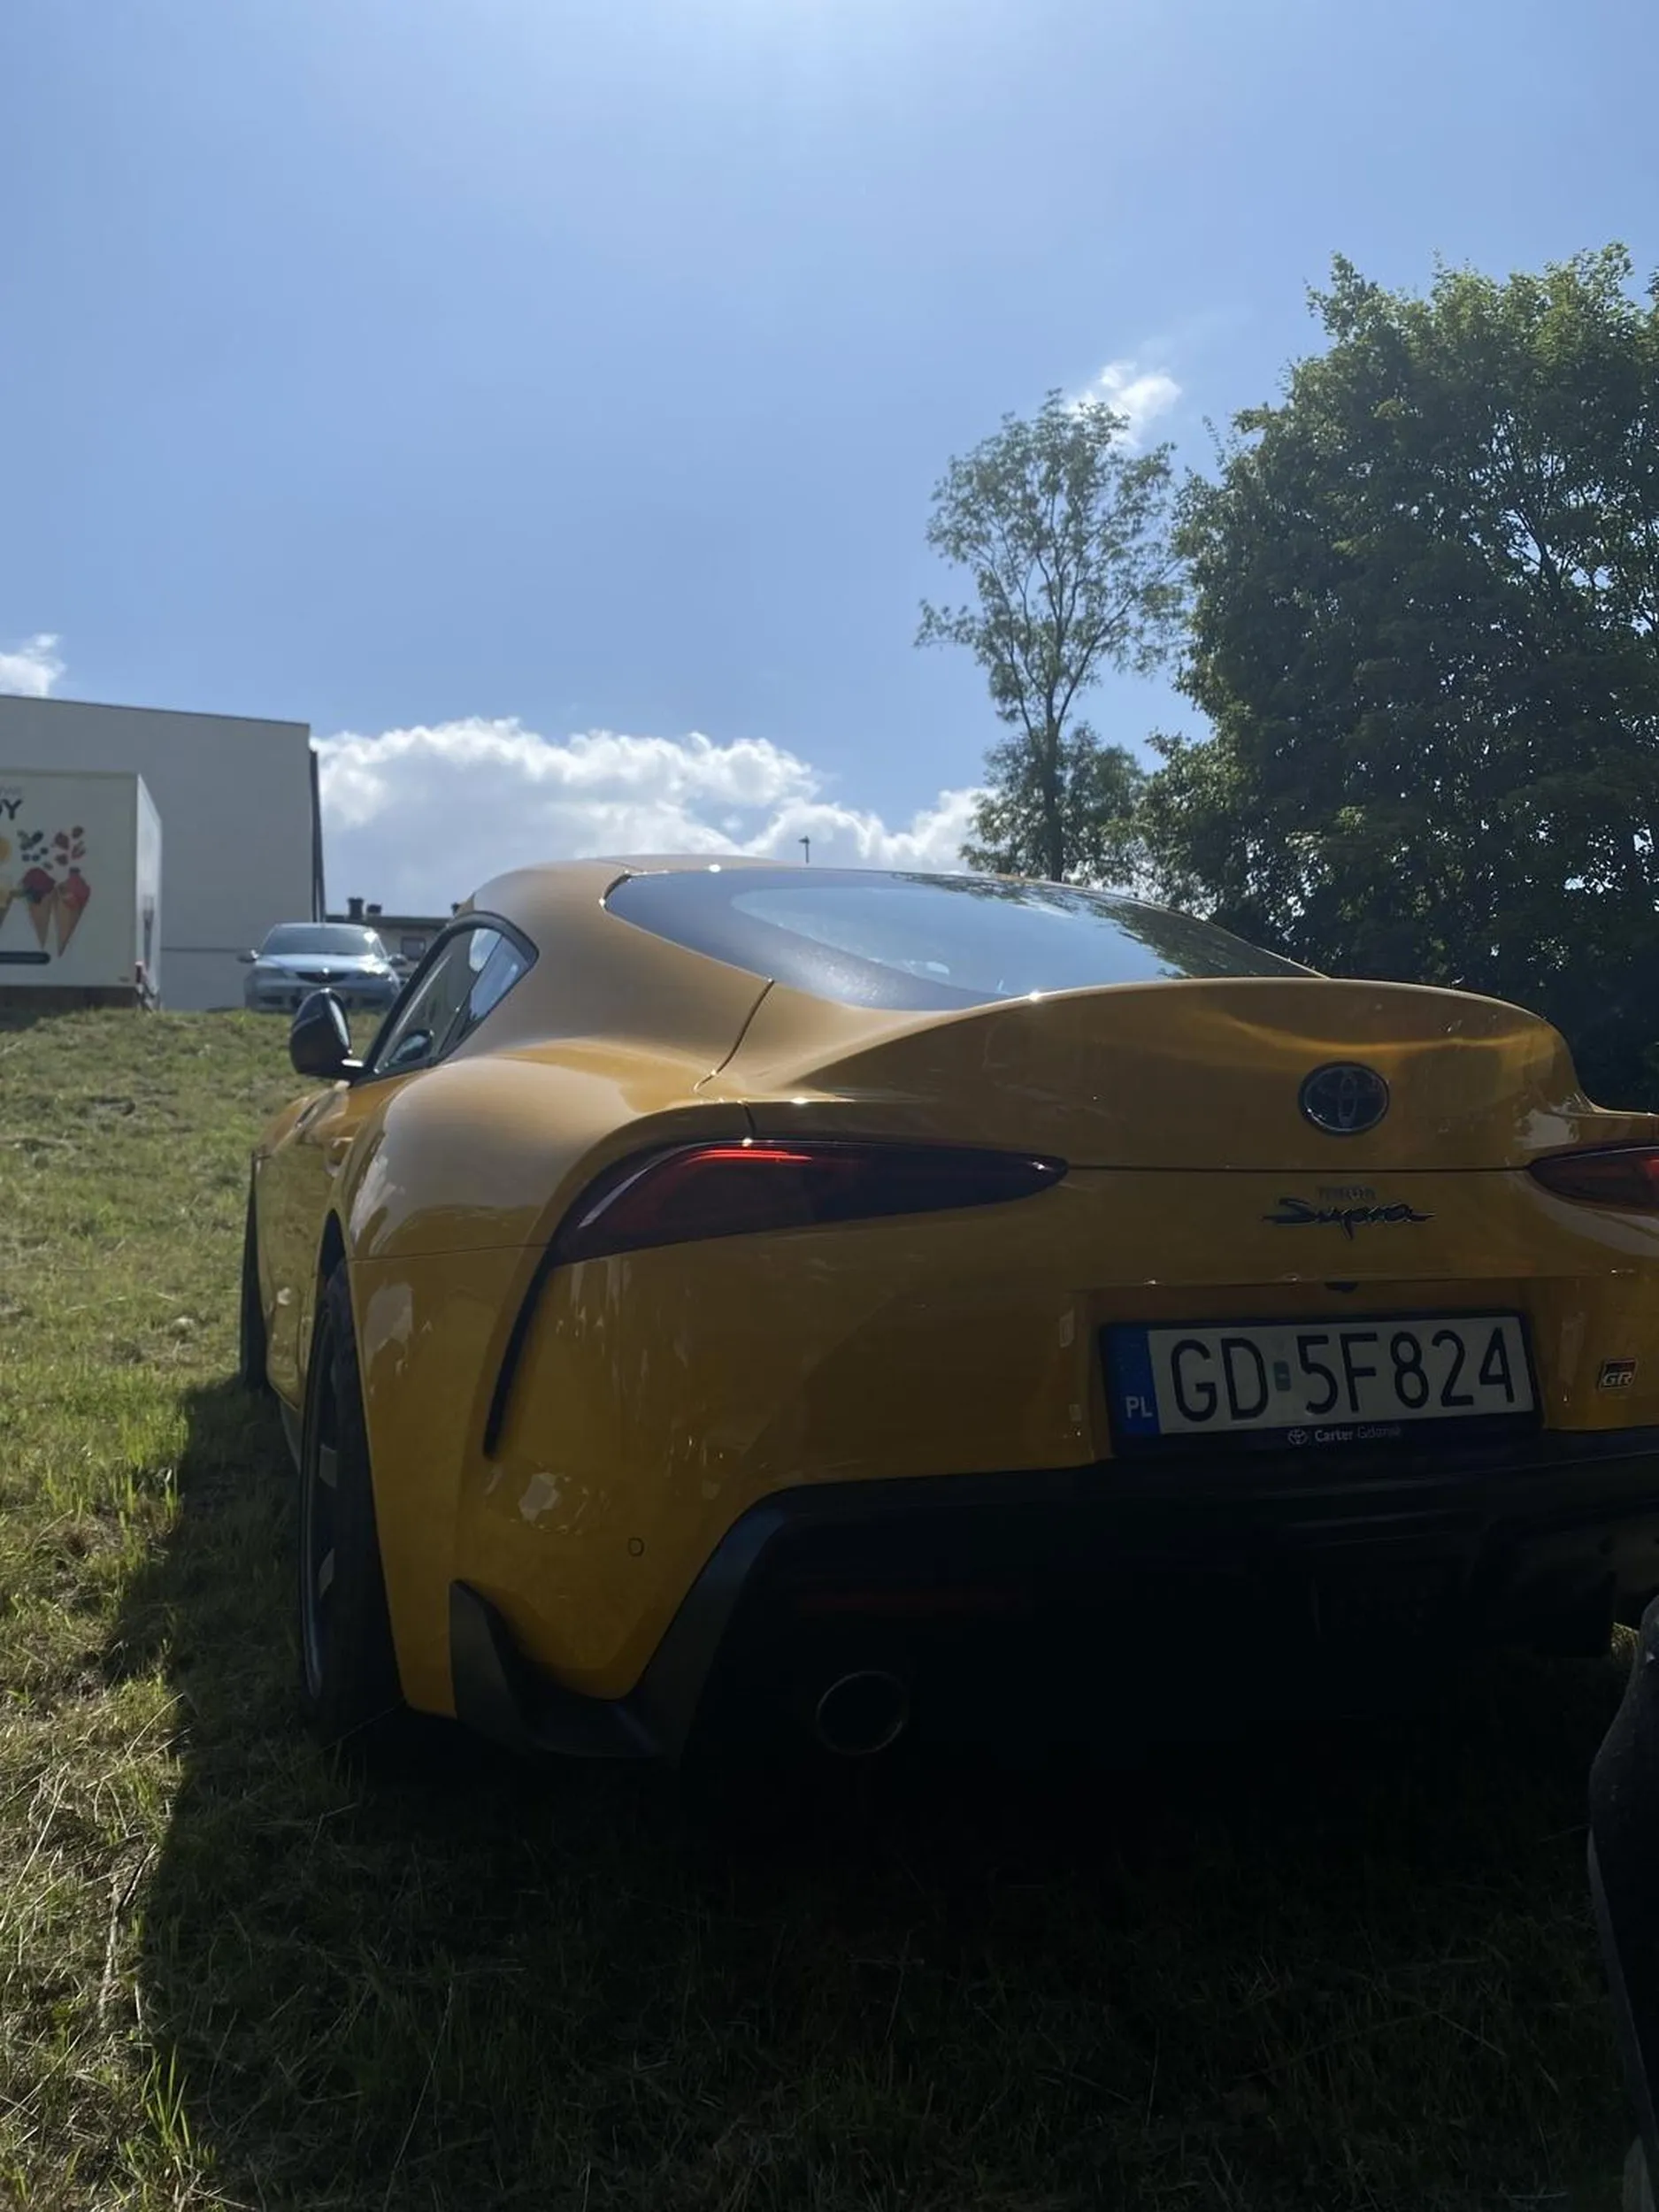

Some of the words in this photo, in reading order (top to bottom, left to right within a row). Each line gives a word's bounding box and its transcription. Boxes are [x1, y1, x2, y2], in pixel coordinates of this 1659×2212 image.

[0, 798, 23, 821] Y
[1259, 1197, 1436, 1240] Supra
[1170, 1336, 1269, 1422] GD
[1295, 1326, 1515, 1415] 5F824
[1125, 1395, 1154, 1419] PL
[1314, 1429, 1354, 1442] Carter
